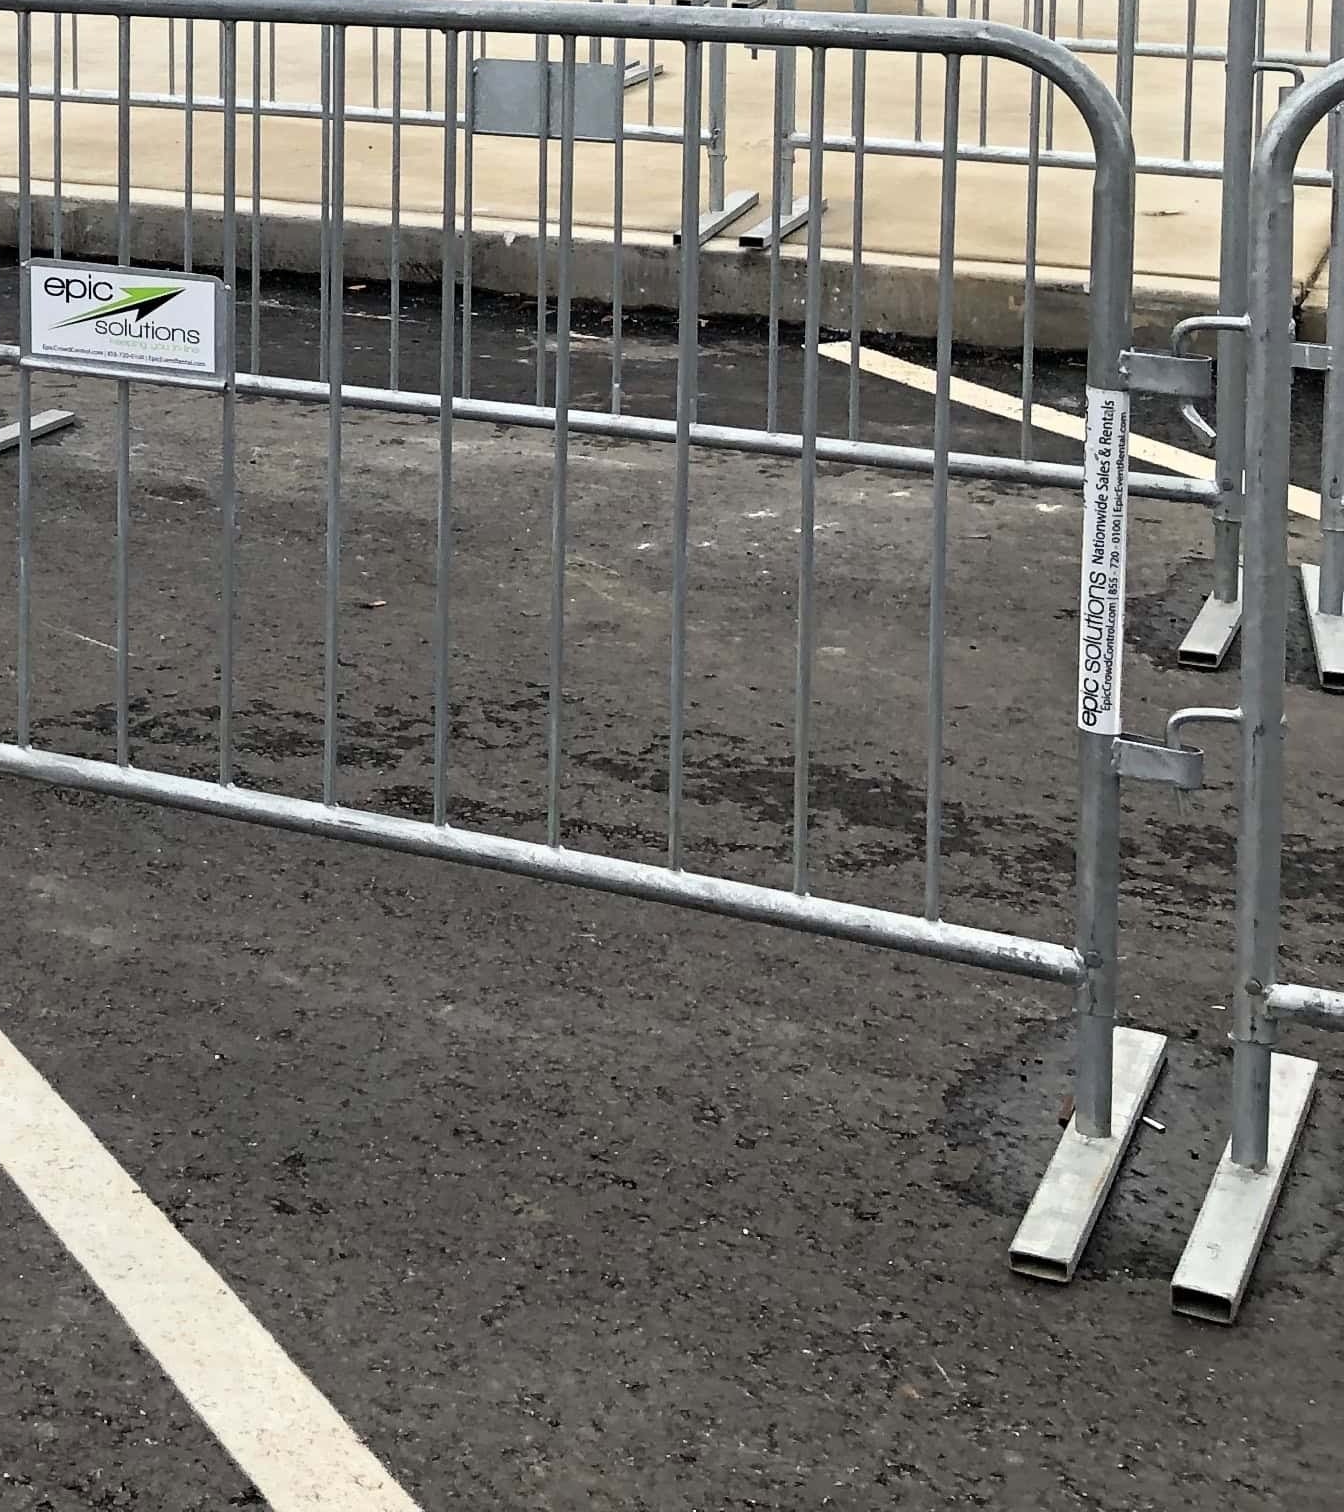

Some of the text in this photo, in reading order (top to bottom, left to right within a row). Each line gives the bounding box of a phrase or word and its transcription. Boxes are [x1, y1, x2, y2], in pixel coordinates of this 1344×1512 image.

[44, 274, 113, 303] epic
[94, 318, 200, 344] solutions
[1080, 400, 1115, 727] epic solutions Nationwide Sales & Rentals
[1100, 412, 1127, 711] EpicCrowdControl.com 855 720 0100 EpicEventRental.com
